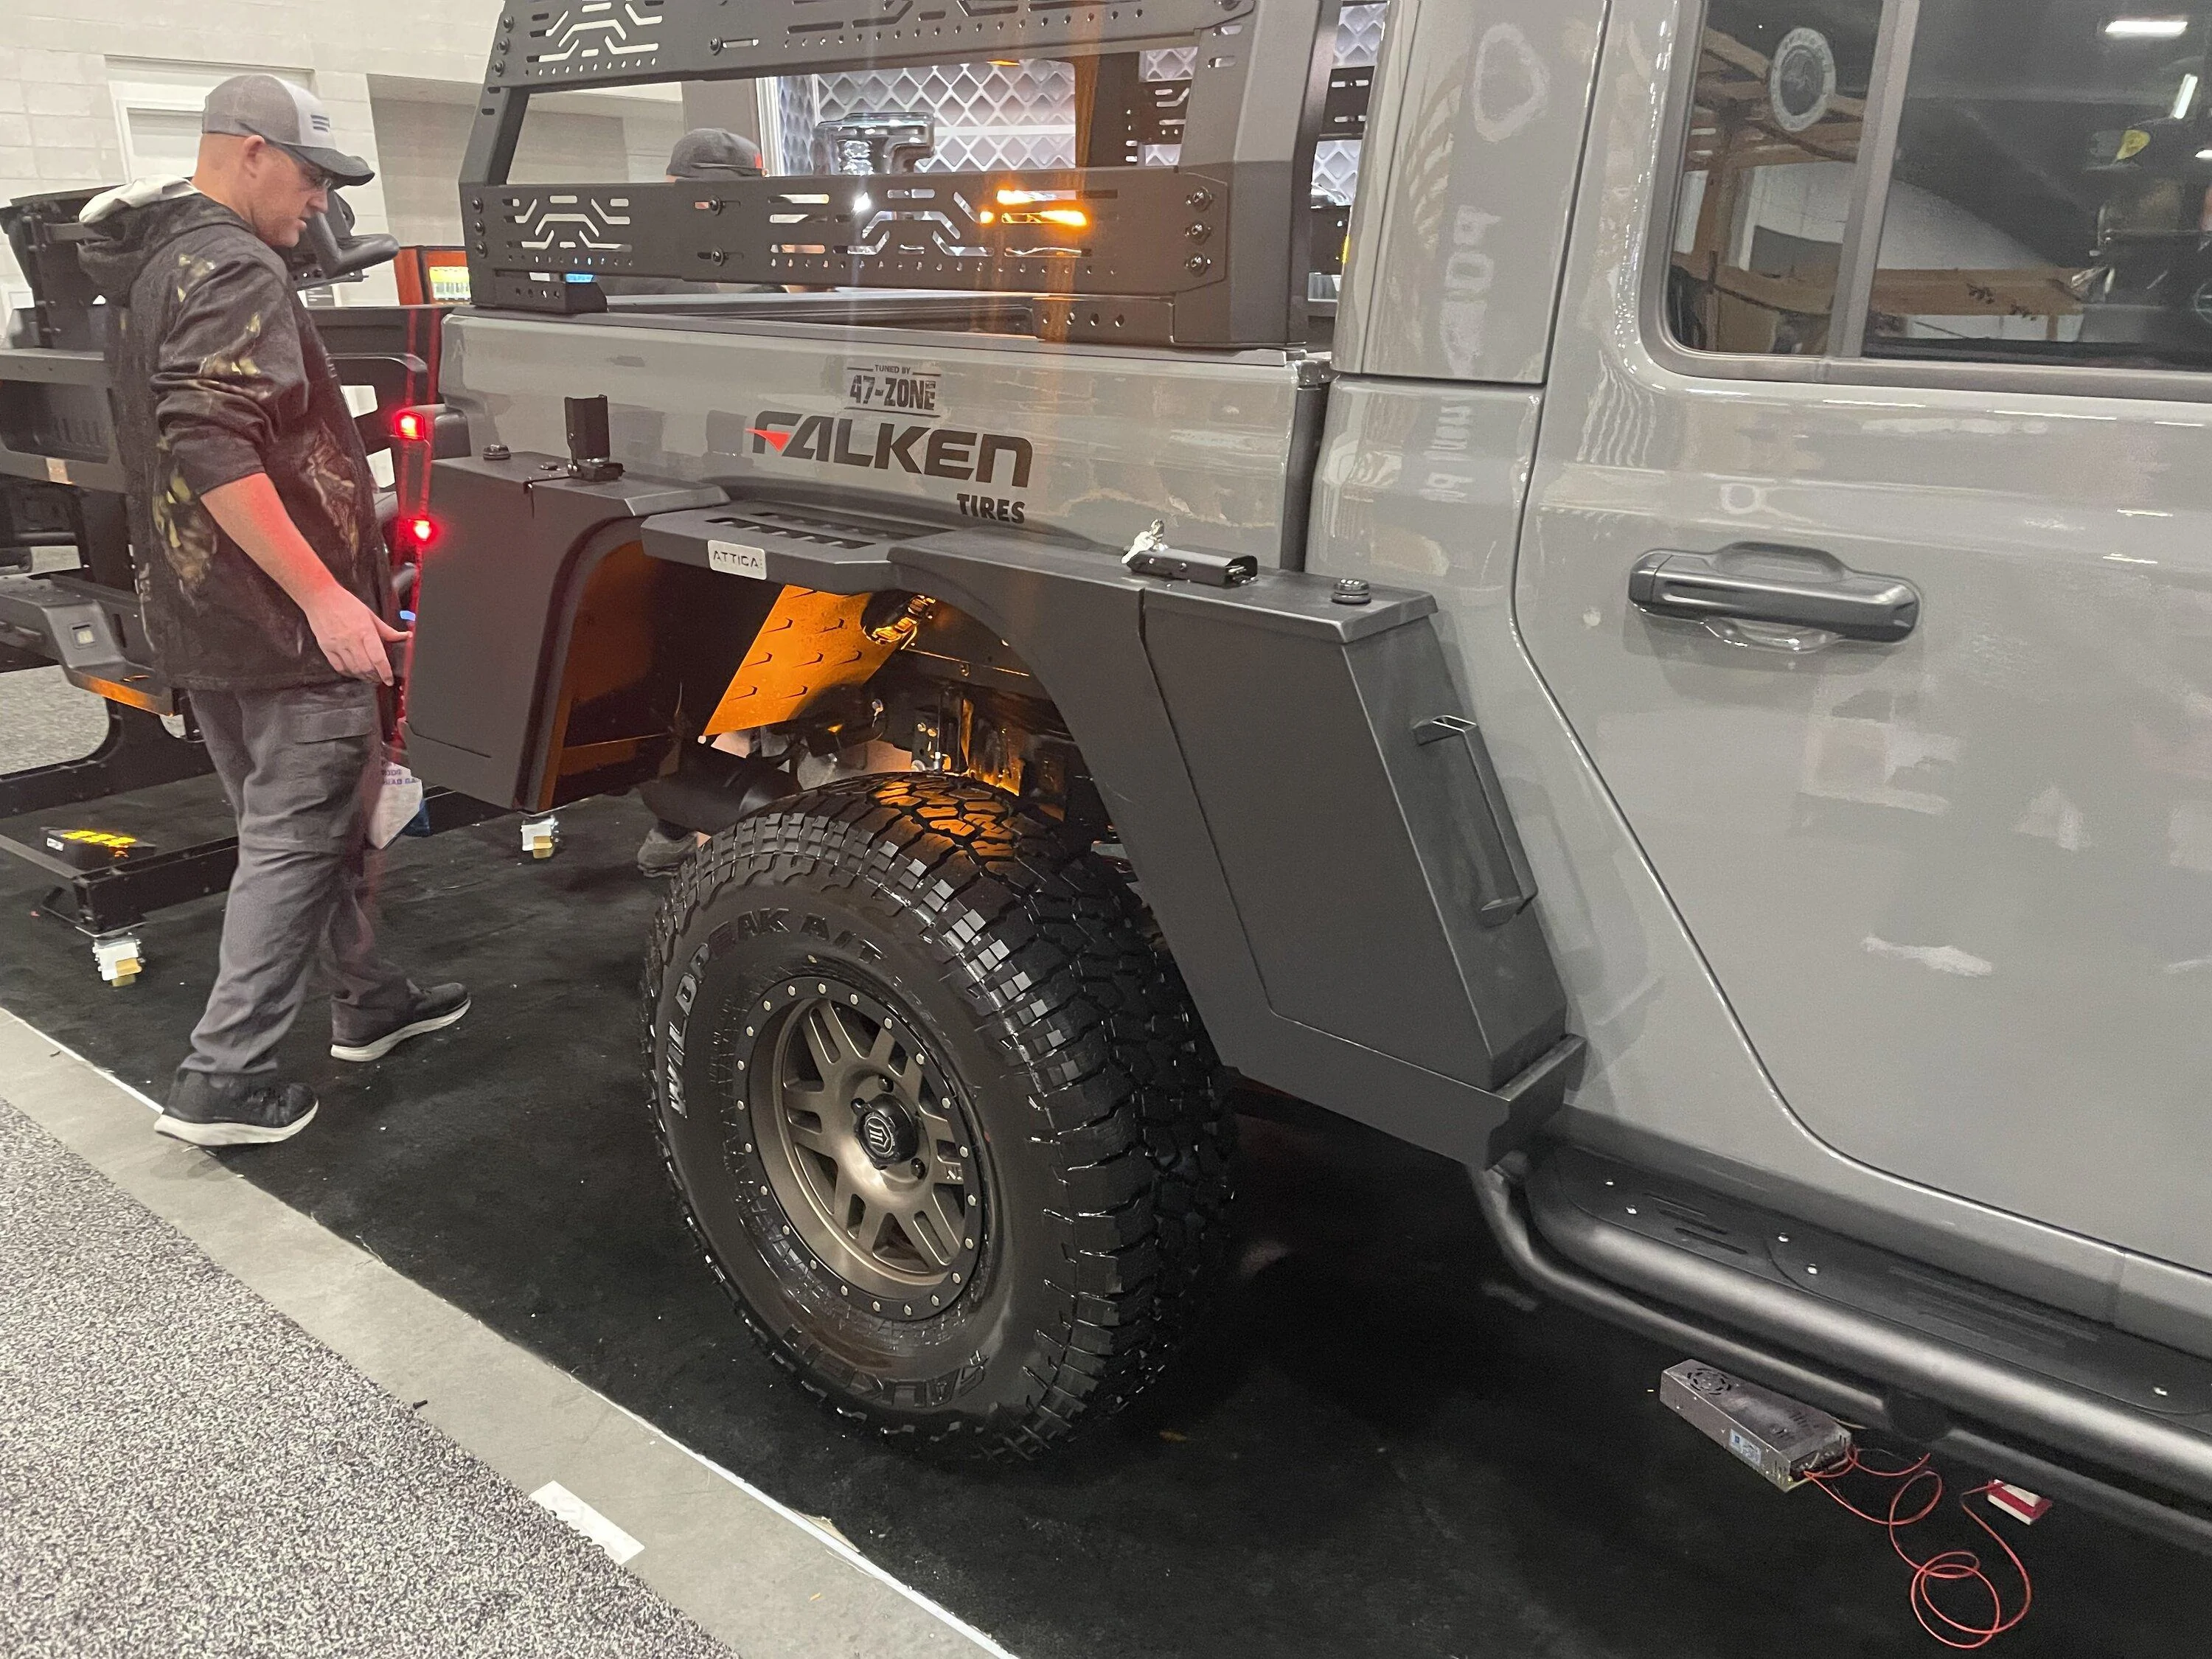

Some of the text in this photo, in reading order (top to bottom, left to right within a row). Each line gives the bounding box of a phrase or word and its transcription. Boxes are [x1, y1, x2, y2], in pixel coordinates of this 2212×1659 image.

[874, 364, 911, 375] TUNED BY
[849, 375, 936, 411] 47-ZONE
[745, 410, 1033, 488] FALKEN
[956, 493, 1026, 525] TIRES
[713, 550, 759, 568] ATTICA
